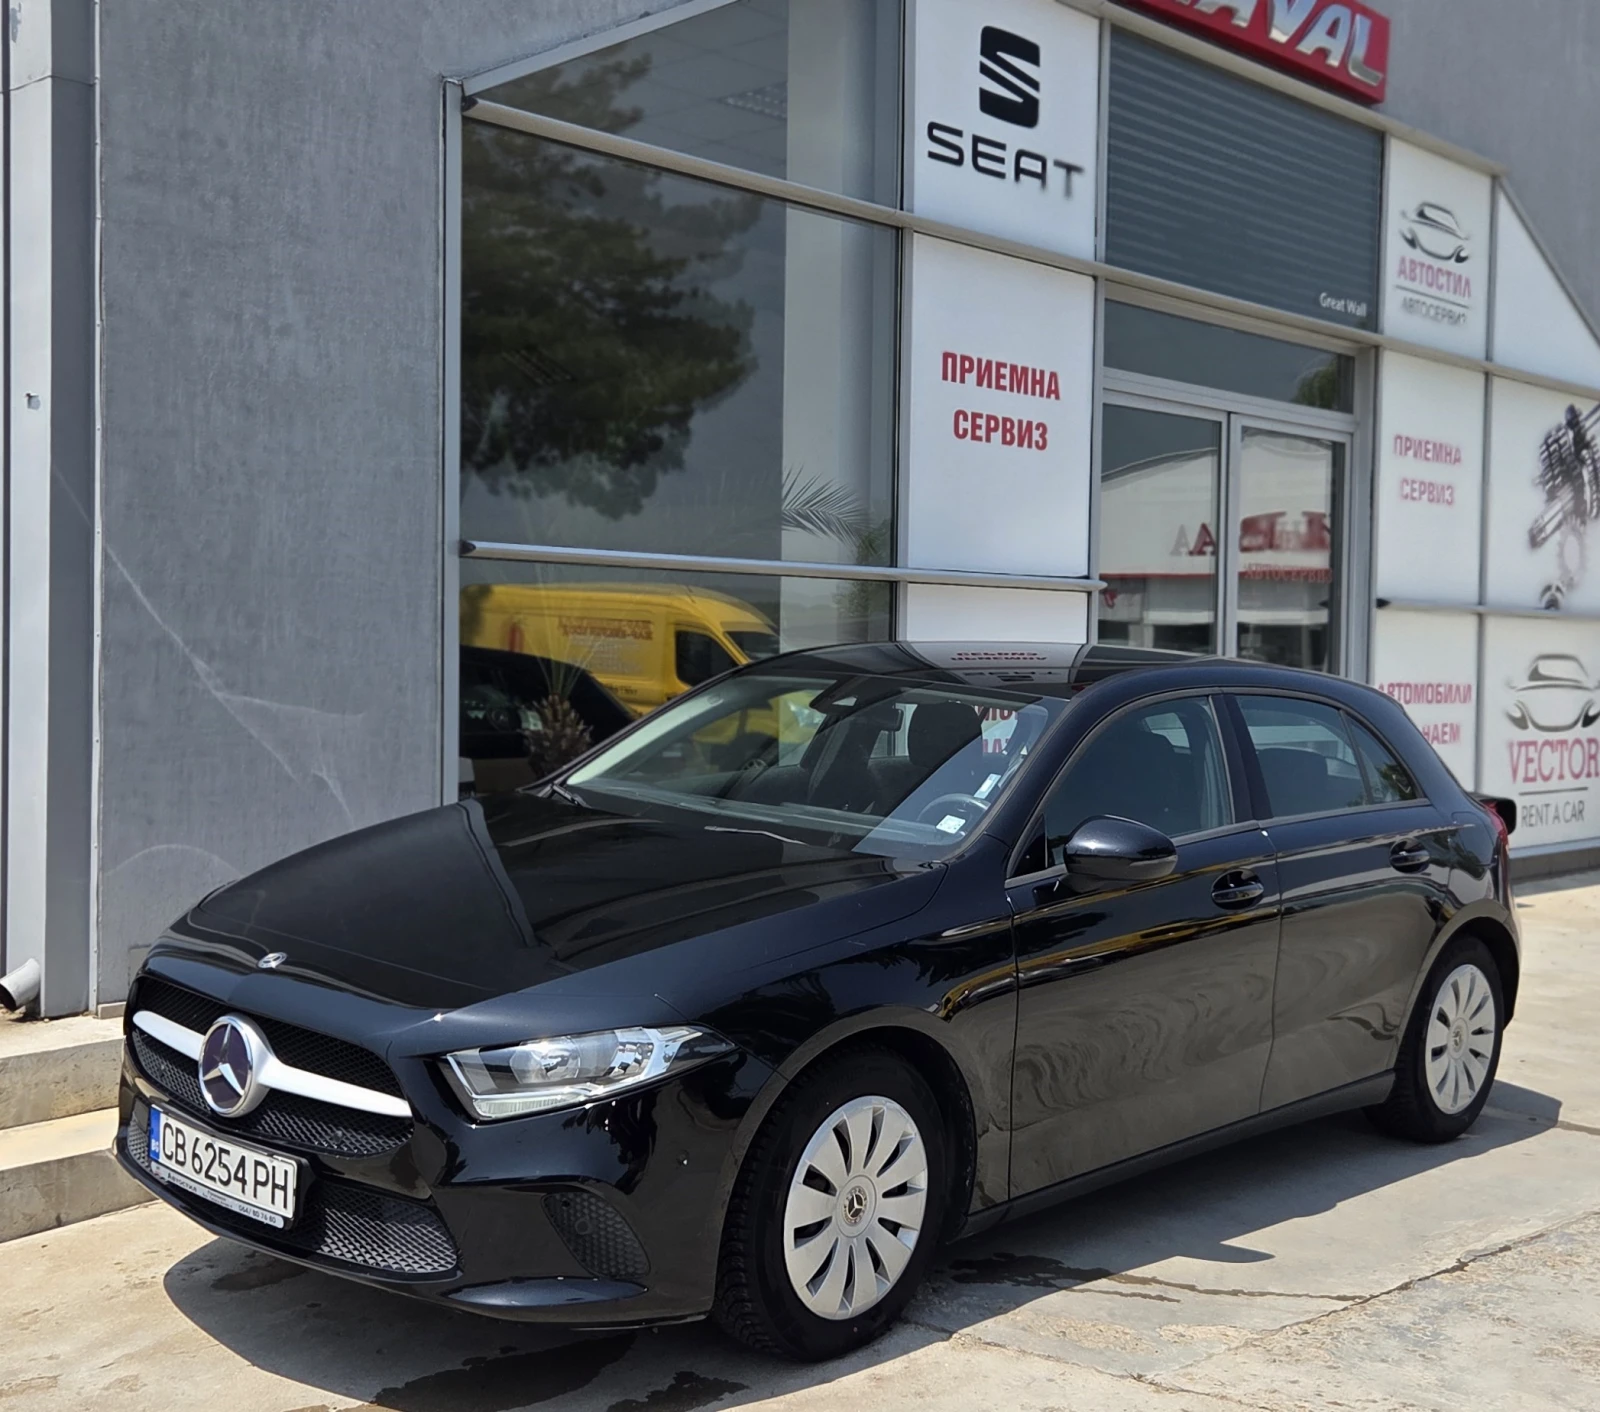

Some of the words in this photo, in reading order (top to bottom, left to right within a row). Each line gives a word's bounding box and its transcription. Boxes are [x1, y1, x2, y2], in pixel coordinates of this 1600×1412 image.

[1174, 0, 1384, 87] VAL
[927, 121, 1085, 198] SEAT
[1396, 254, 1472, 299] АВТОСТИЛ
[1319, 292, 1345, 313] Great
[1346, 297, 1367, 318] Wall
[941, 351, 1061, 401] ПРИЕМНА
[953, 409, 1048, 451] СЕРВИЗ
[1393, 434, 1462, 466] ПРИЕМНА
[1399, 477, 1455, 506] СЕРВИЗ
[1506, 736, 1600, 784] VECTOR
[1520, 803, 1551, 828] RENT
[1552, 802, 1561, 825] A
[1562, 799, 1585, 824] CAR
